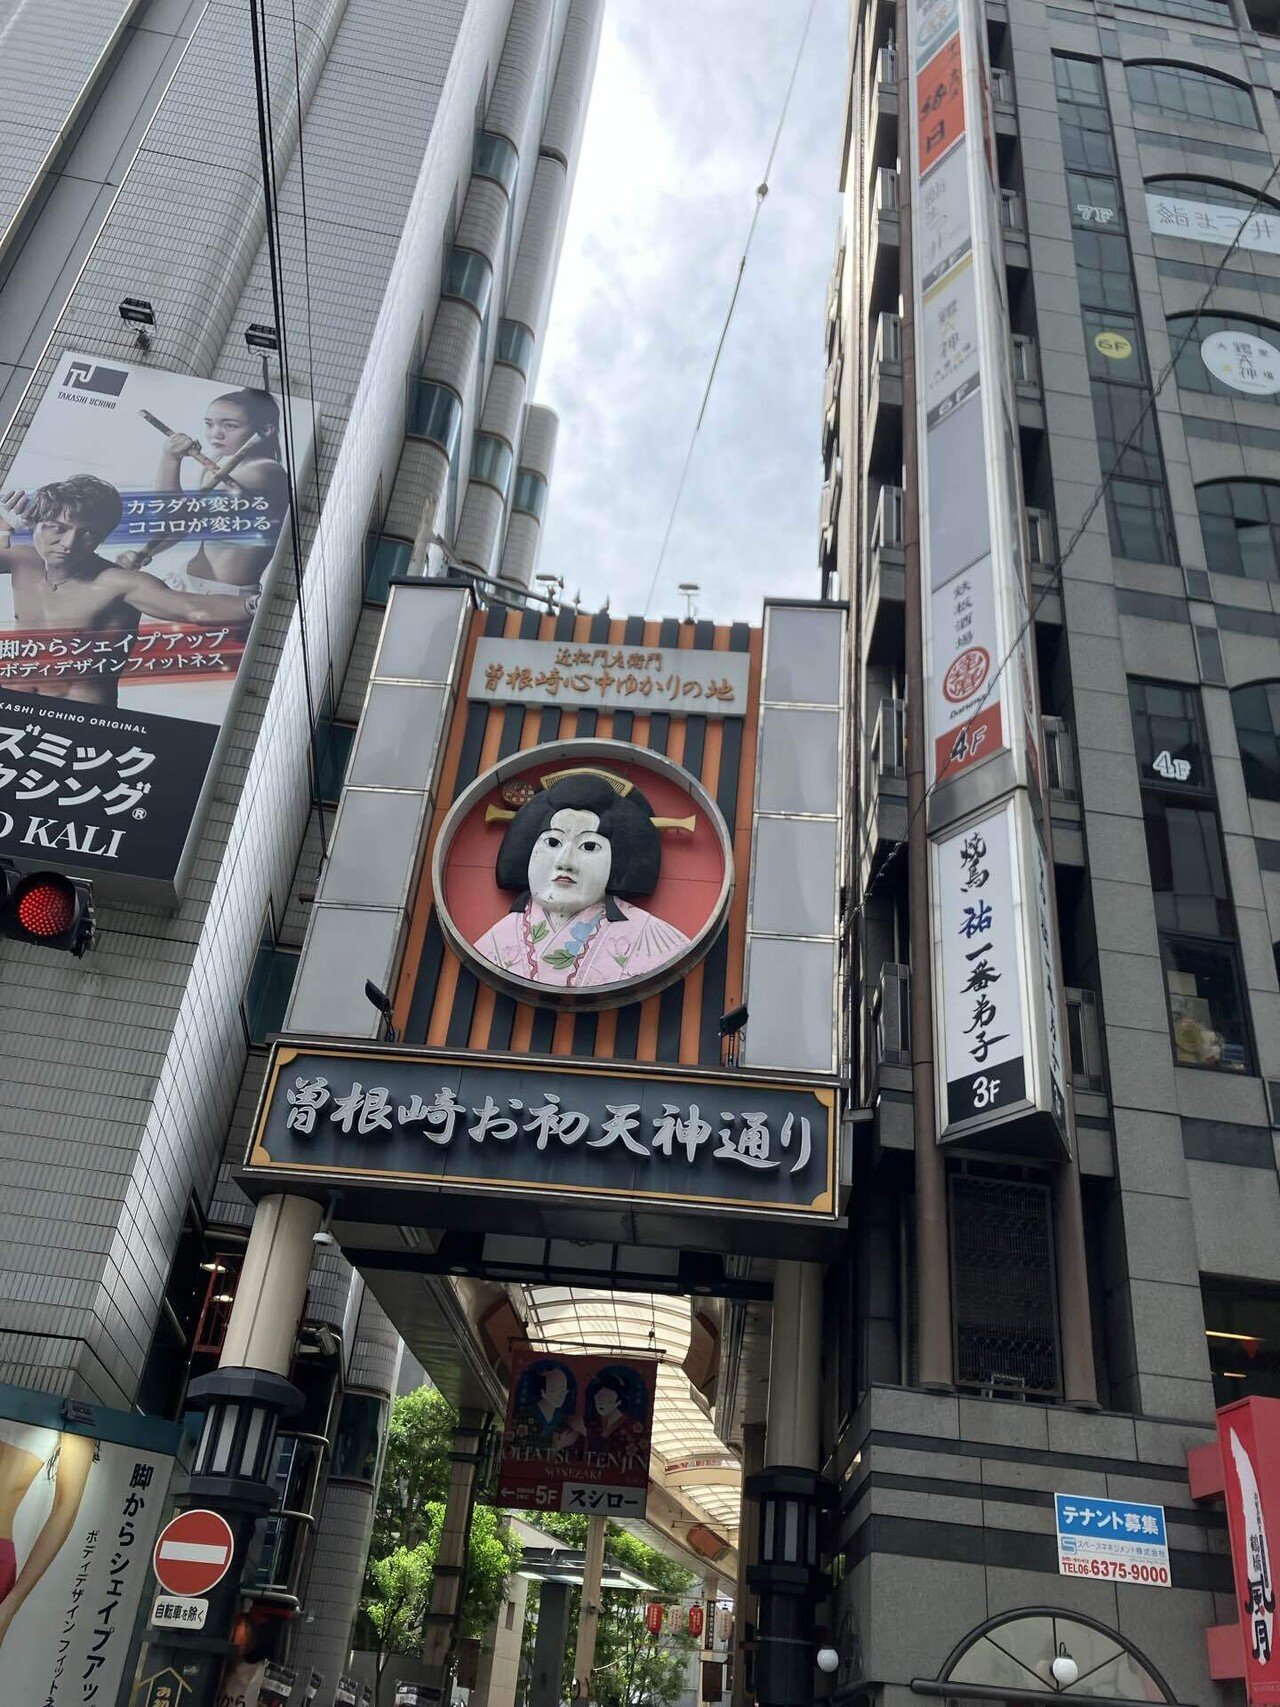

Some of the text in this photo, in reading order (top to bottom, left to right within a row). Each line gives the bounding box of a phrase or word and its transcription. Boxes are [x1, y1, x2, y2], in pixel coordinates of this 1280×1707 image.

[58, 391, 117, 410] TAKASHI UCHINO
[127, 495, 270, 516] カラダが変わる
[128, 515, 272, 534] ココロが変わる
[0, 652, 225, 678] ボディデザインフィットネス
[554, 646, 663, 672] 近松門左衛門
[39, 709, 85, 723] UCHINO
[90, 717, 147, 734] ORIGINAL
[951, 724, 988, 762] 4F
[1153, 750, 1191, 781] 4F
[20, 815, 126, 858] KALI
[972, 1075, 1001, 1108] 3F
[535, 1485, 558, 1505] 5F
[568, 1489, 639, 1509] スシロー
[1063, 1506, 1159, 1535] テナント募集
[81, 1462, 154, 1707] 脚からシェイプアッ
[155, 1602, 204, 1622] 自転車を除く
